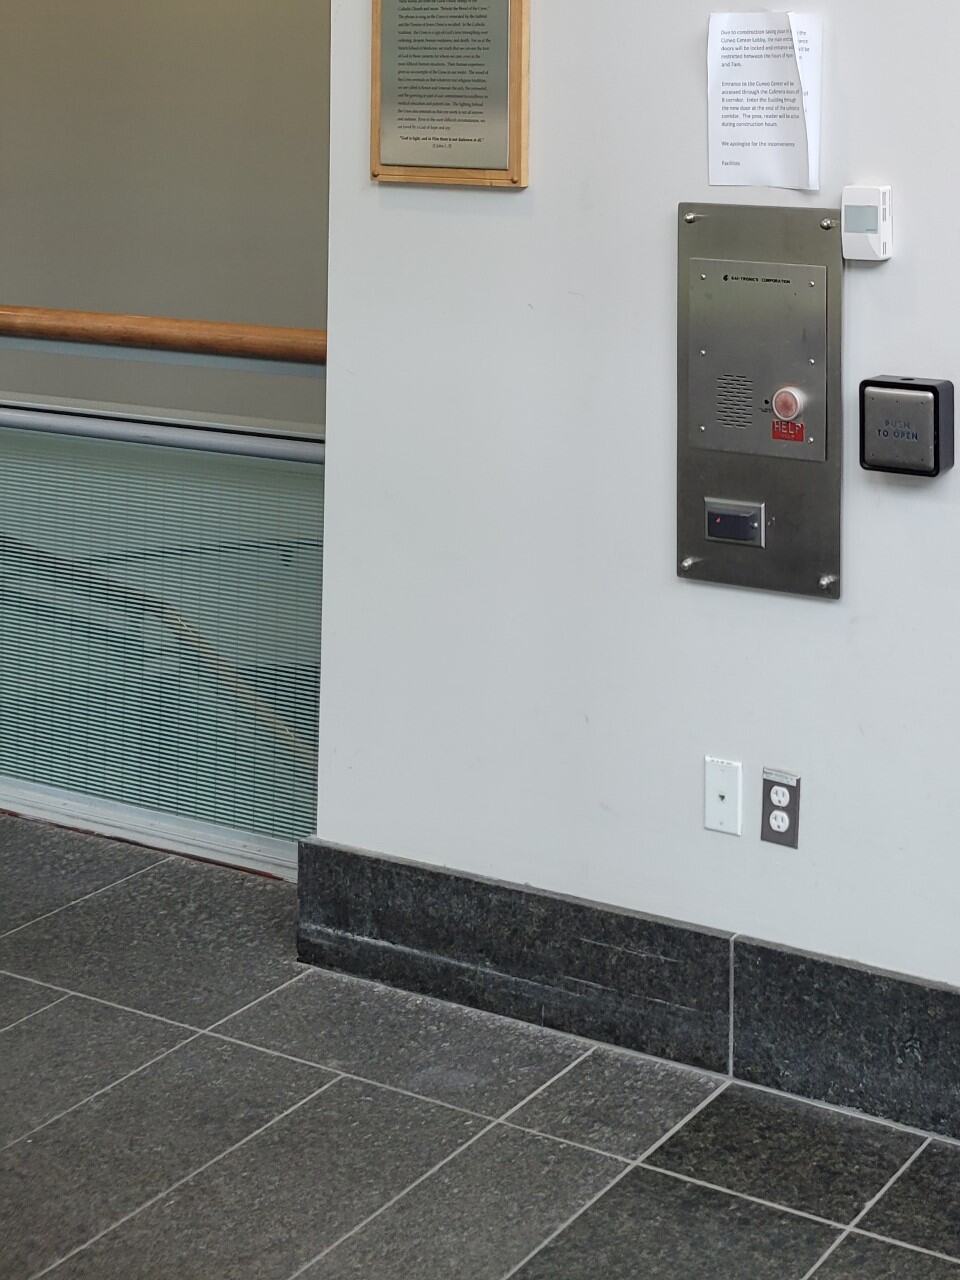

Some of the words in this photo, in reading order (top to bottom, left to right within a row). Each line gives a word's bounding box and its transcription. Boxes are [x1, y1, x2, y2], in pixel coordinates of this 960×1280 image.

[774, 421, 802, 434] HELP
[877, 428, 889, 437] TO
[893, 431, 918, 440] OPEN
